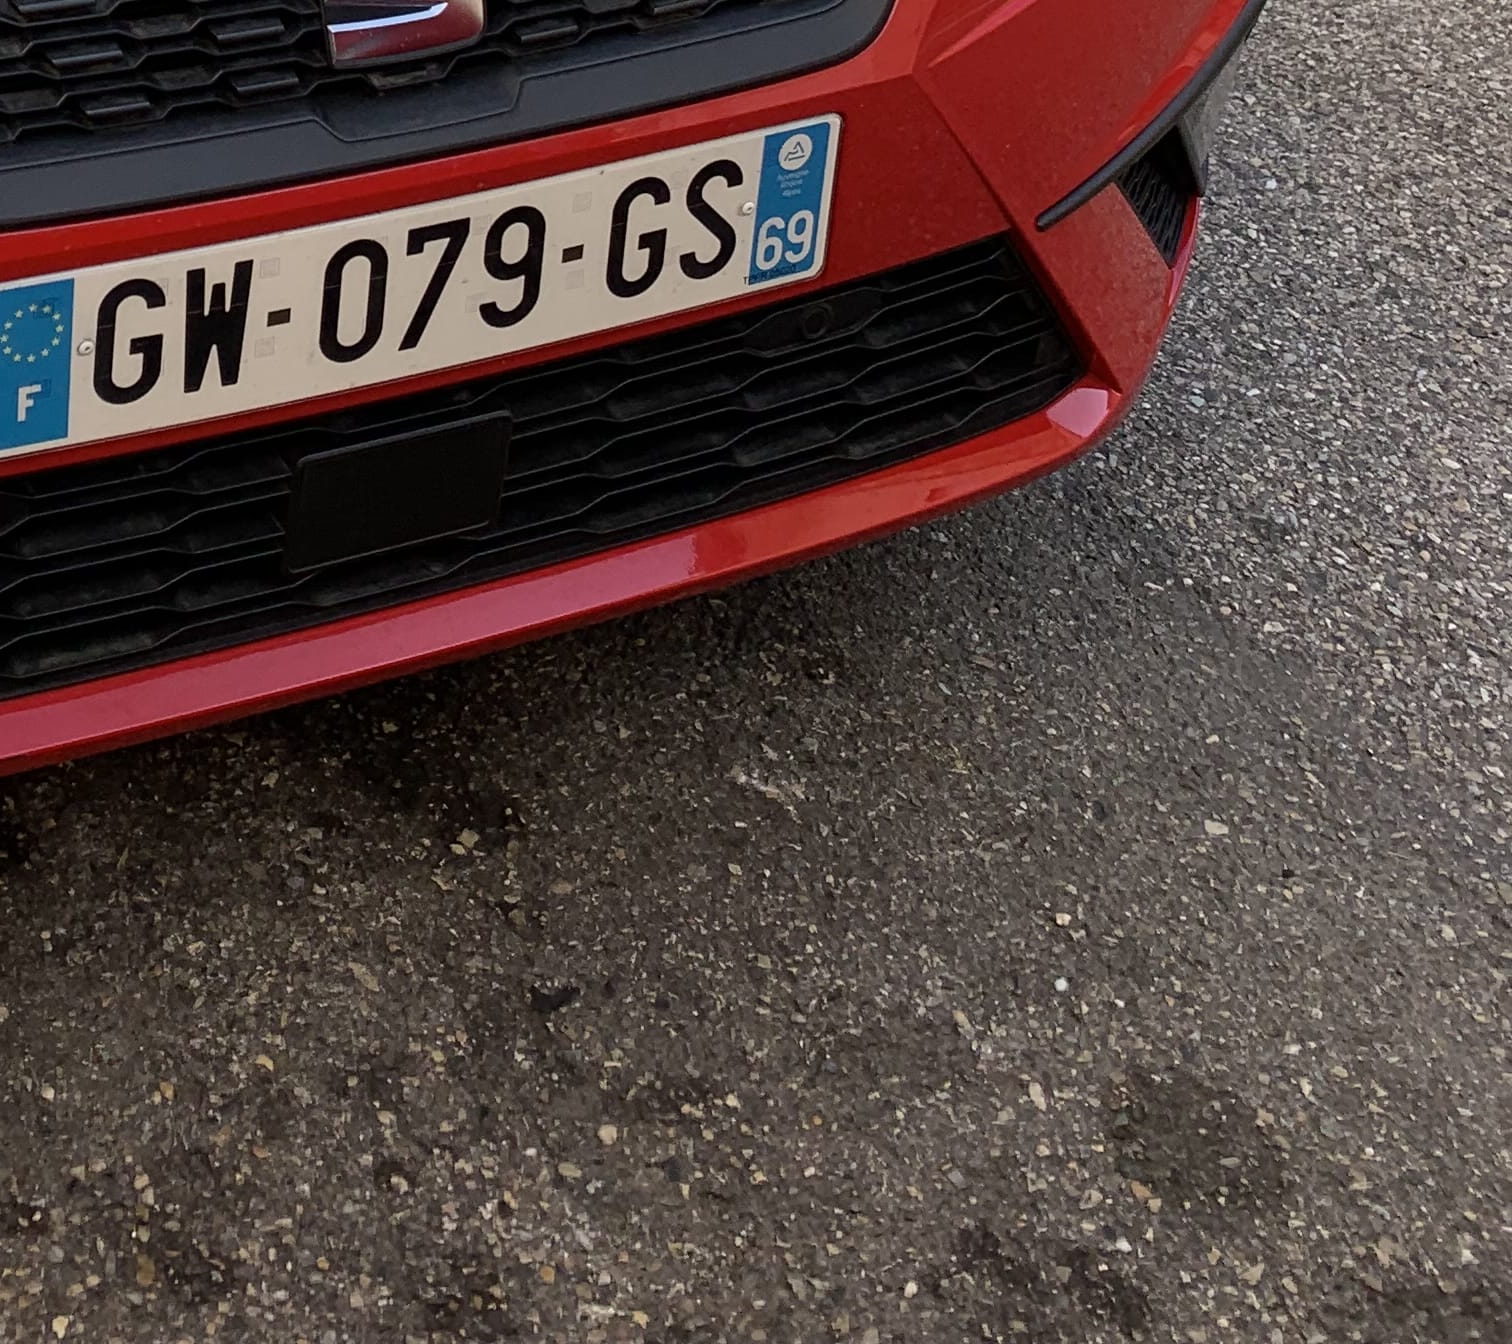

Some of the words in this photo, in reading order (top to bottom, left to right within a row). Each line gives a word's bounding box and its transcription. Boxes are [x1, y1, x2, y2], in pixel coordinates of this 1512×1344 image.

[755, 209, 814, 270] 69
[93, 159, 744, 405] GW-079-GS
[17, 384, 42, 422] F
